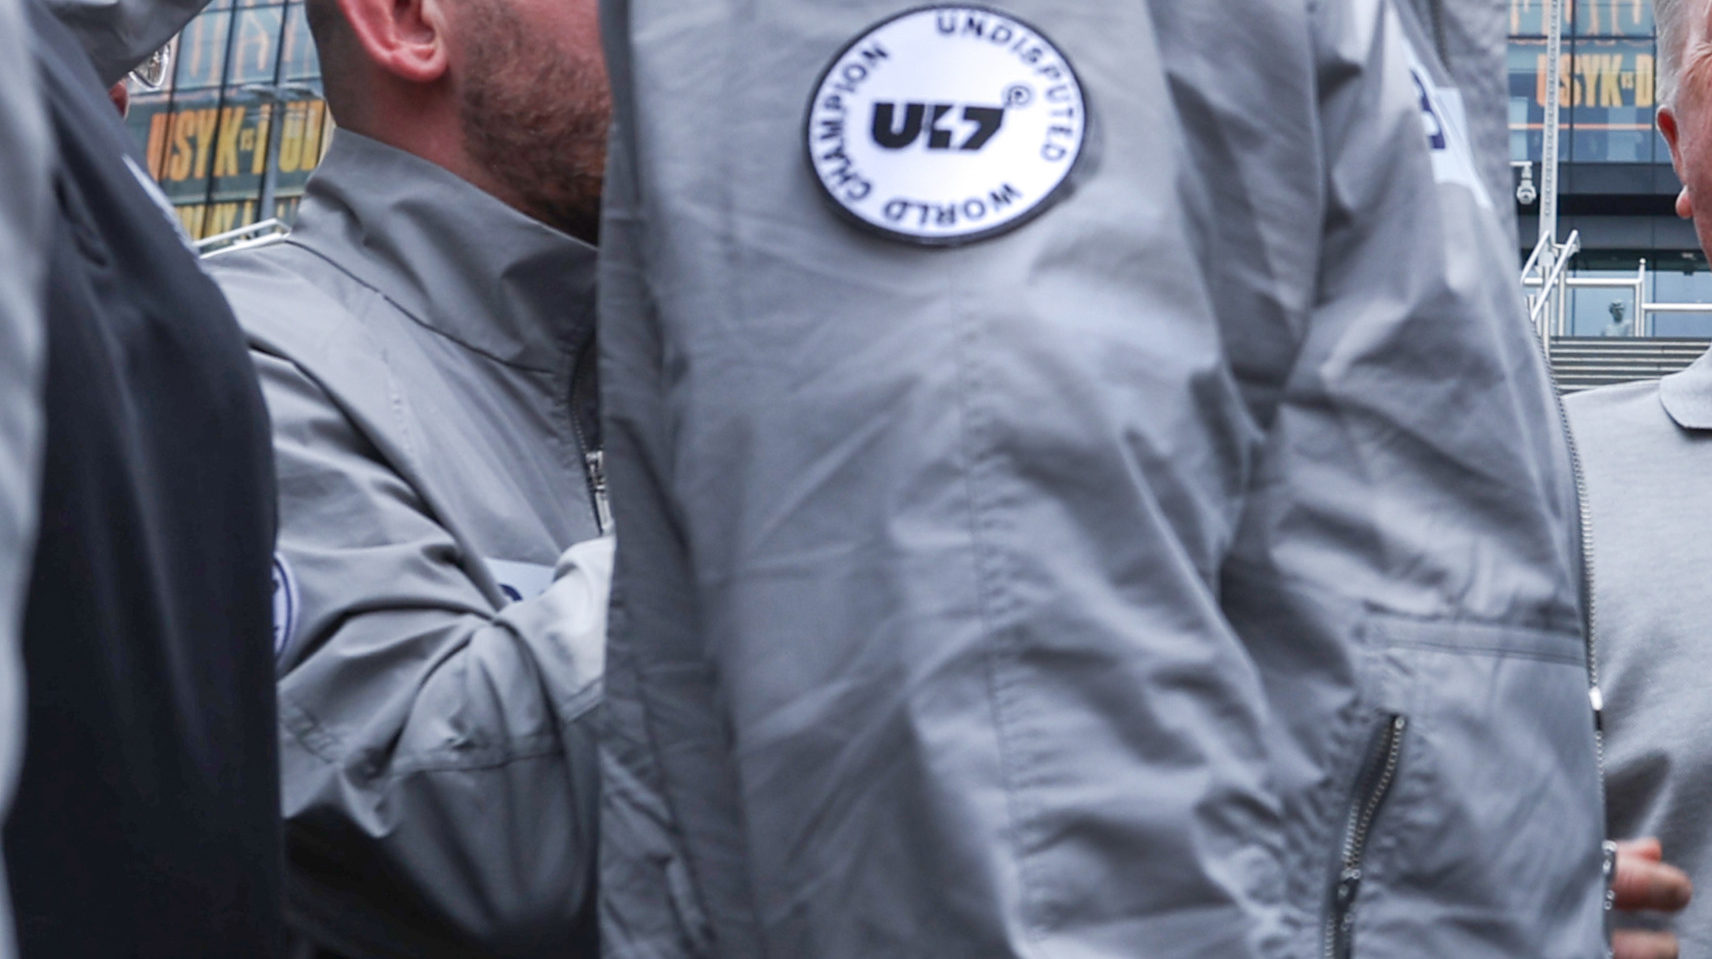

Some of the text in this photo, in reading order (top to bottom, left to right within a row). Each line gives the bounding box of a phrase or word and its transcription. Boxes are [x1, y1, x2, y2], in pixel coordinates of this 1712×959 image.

[146, 106, 246, 182] USYK
[819, 11, 1074, 226] UNDISPUTED WORLD CHAMPION
